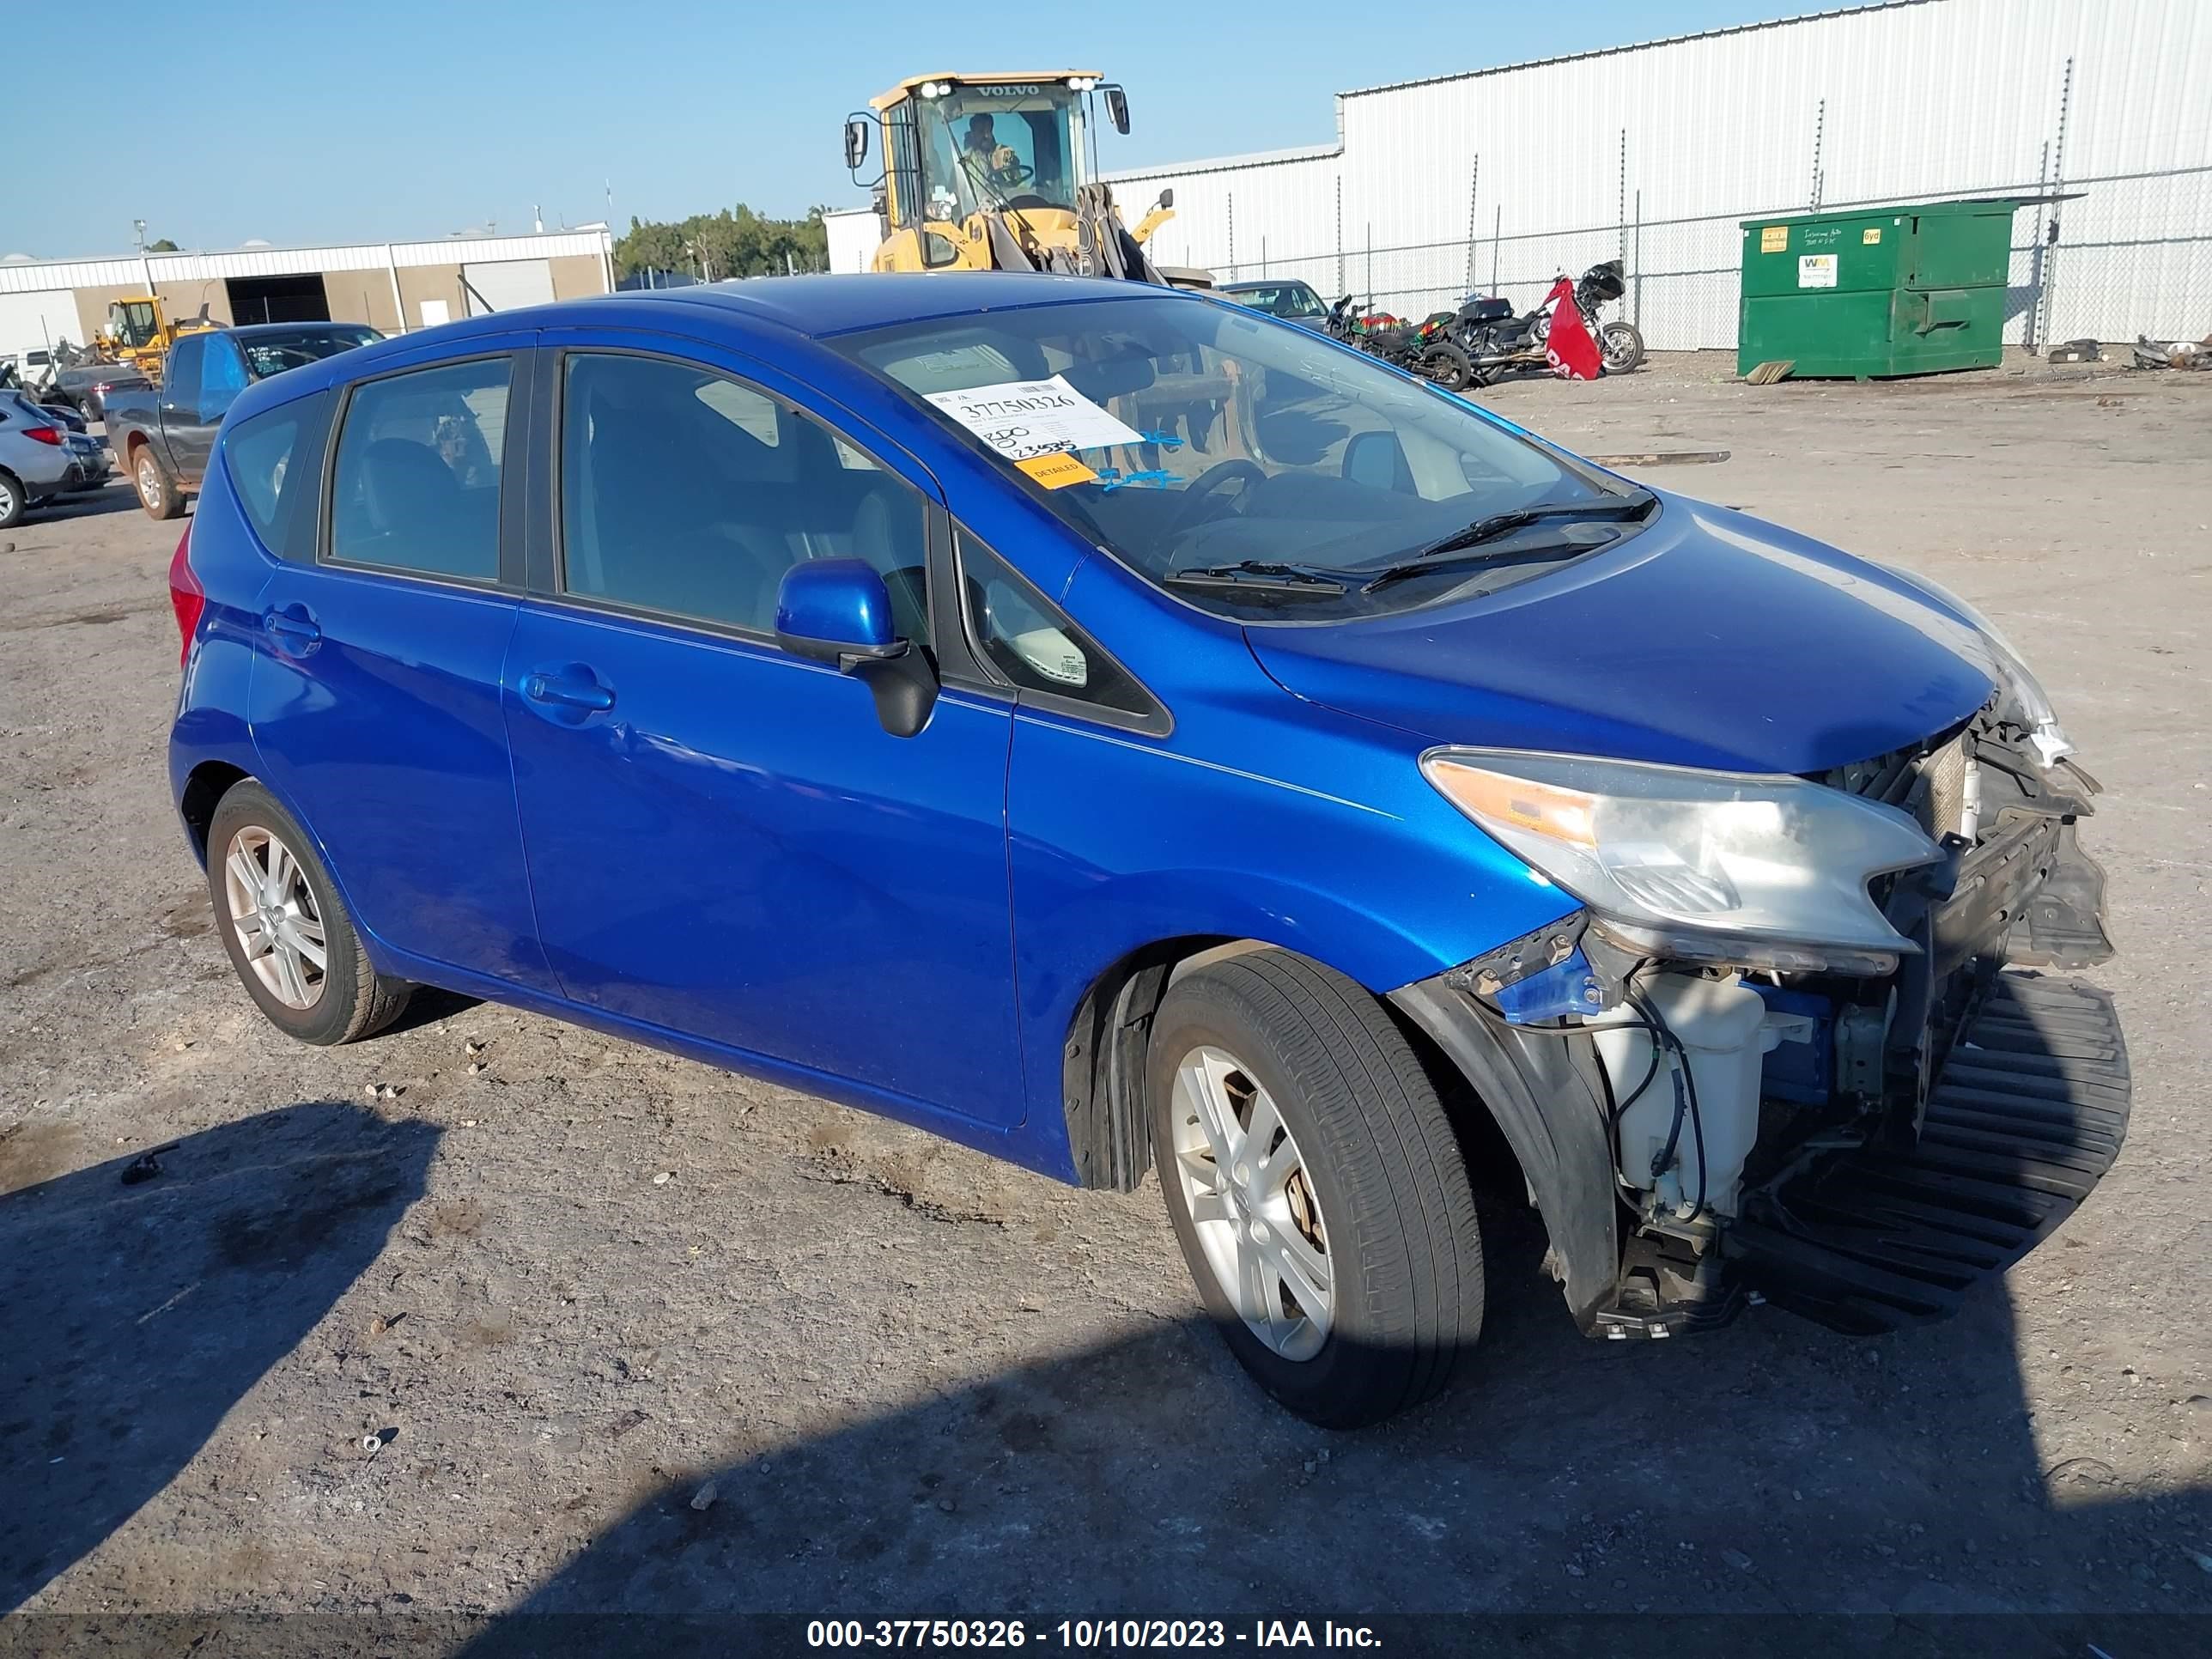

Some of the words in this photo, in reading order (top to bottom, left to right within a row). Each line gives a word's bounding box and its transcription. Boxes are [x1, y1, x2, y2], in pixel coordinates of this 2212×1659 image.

[976, 85, 1039, 96] VOLVO
[1864, 231, 1879, 241] 6yd
[1805, 258, 1830, 268] WM
[960, 394, 1076, 419] 37750326
[1034, 464, 1079, 478] DETAILED
